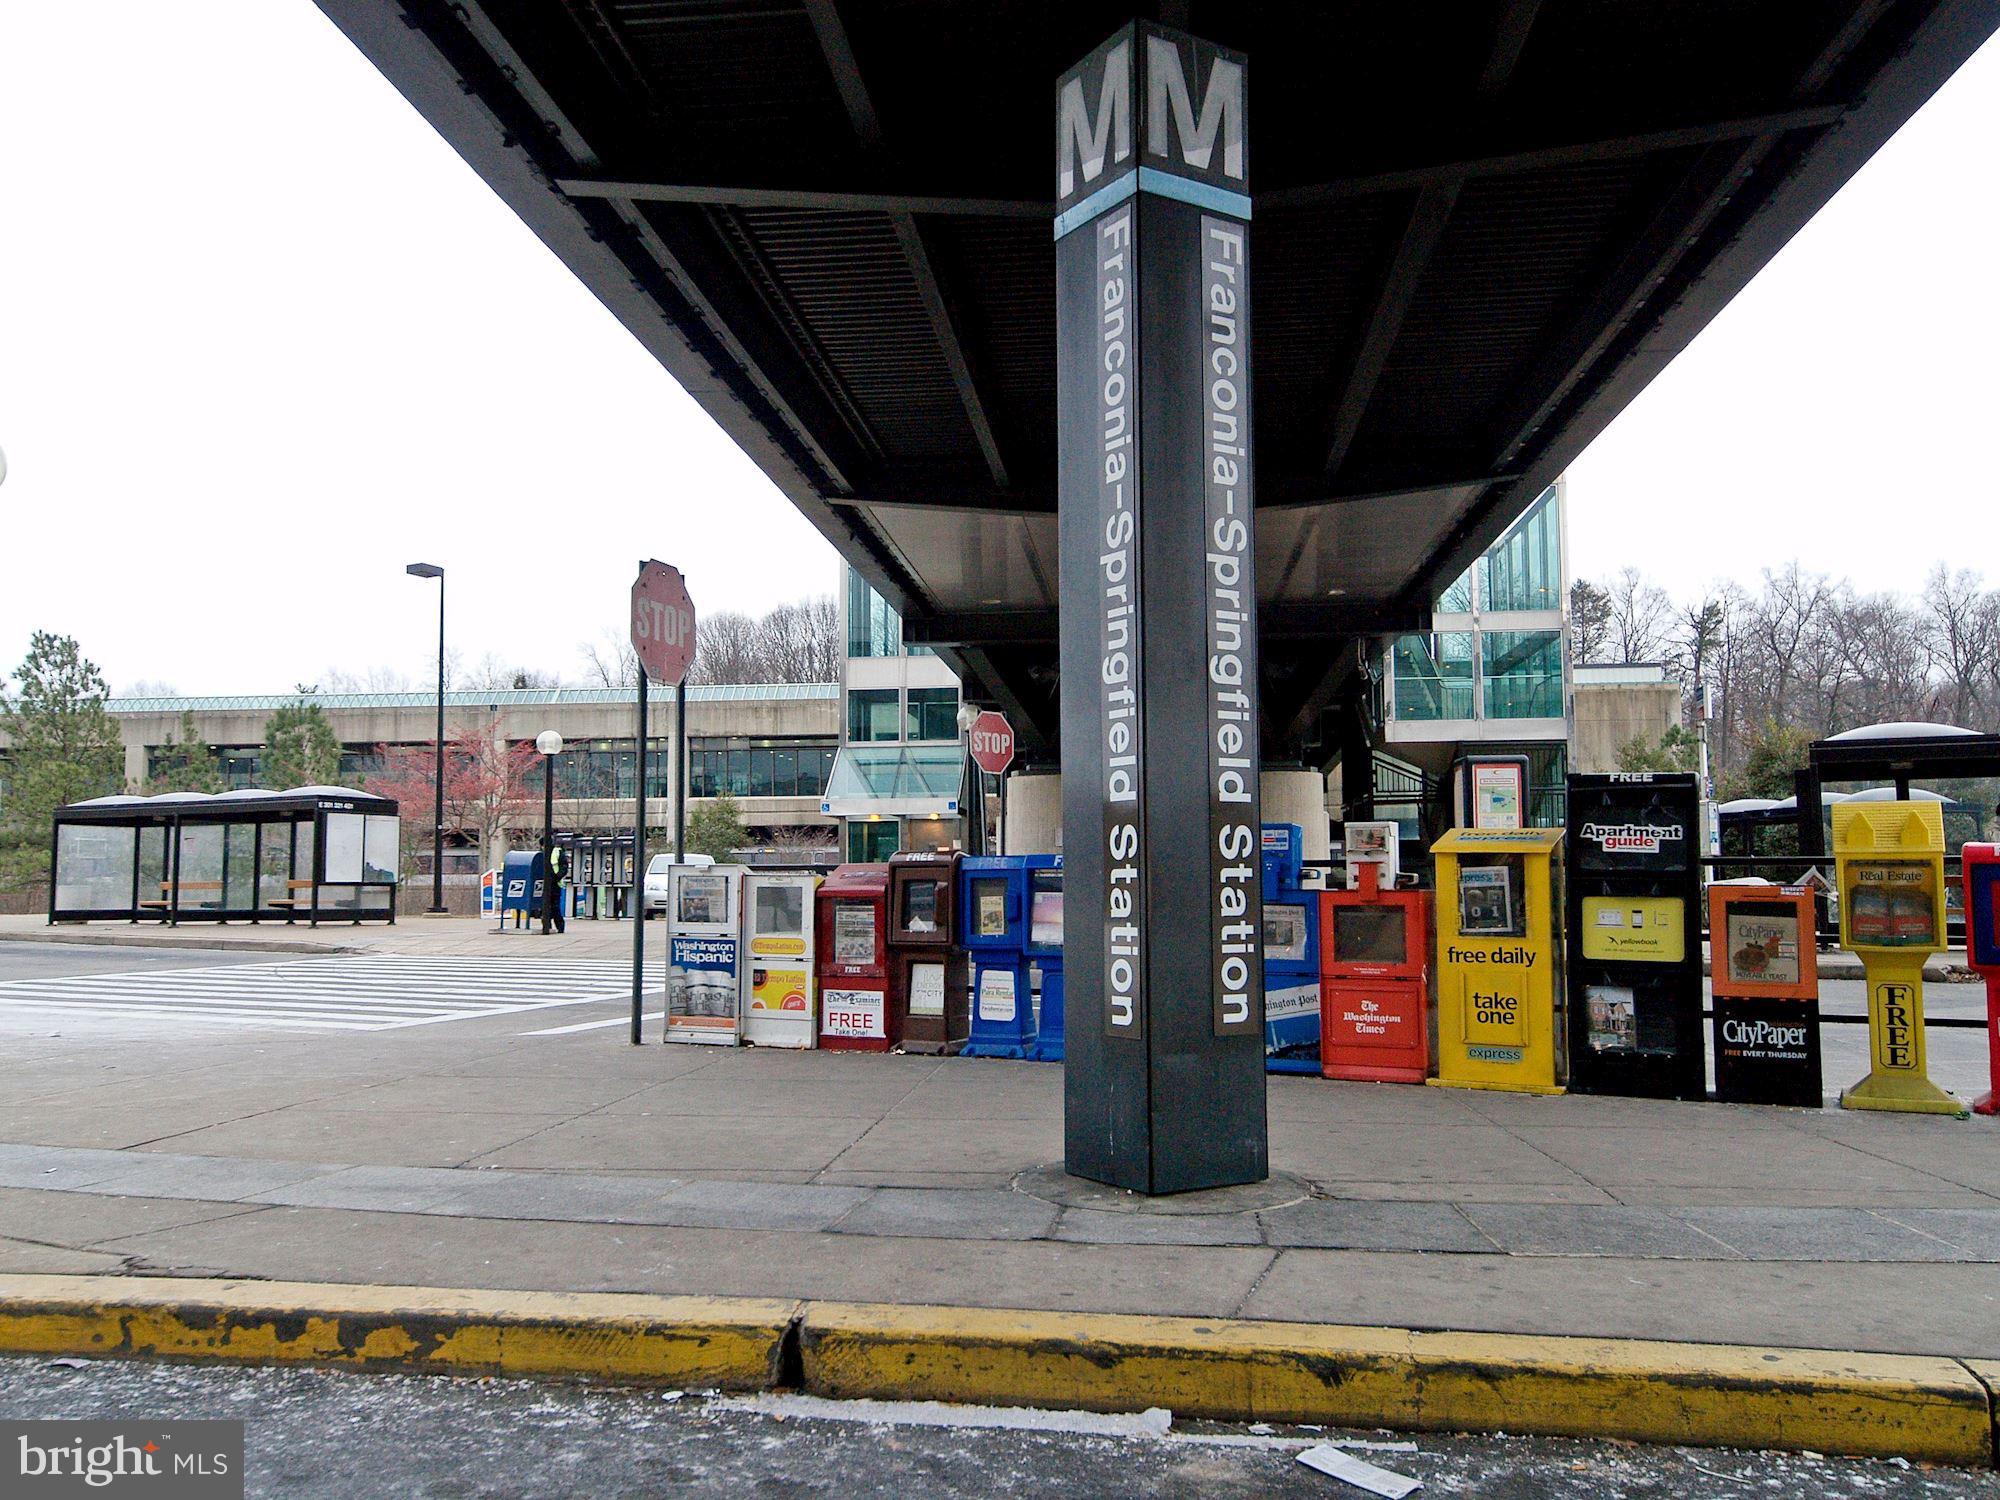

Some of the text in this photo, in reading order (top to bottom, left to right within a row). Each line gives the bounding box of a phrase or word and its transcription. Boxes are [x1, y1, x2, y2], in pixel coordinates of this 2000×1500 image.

[1147, 34, 1243, 180] M
[1060, 38, 1130, 200] M
[637, 596, 691, 648] STOP
[973, 732, 1010, 755] STOP
[1609, 774, 1654, 782] FREE
[1581, 824, 1681, 838] Apartment
[1605, 833, 1655, 849] guide
[906, 853, 936, 861] FREE
[1860, 871, 1922, 882] Real Estate
[1110, 824, 1138, 1025] Station
[1218, 824, 1254, 1024] Station
[1739, 924, 1784, 940] CityPaper
[674, 940, 734, 952] Washington
[675, 950, 733, 964] Hispanic
[1448, 946, 1536, 967] free daily
[1299, 993, 1318, 1007] Post
[1361, 1000, 1379, 1012] The
[1473, 992, 1517, 1010] take
[829, 1012, 873, 1029] FREE
[1343, 1012, 1401, 1023] Washington
[1477, 1010, 1515, 1025] one
[1355, 1022, 1385, 1034] Times
[1884, 987, 1910, 1066] FREE
[1723, 1020, 1806, 1049] CityPaper
[1469, 1048, 1520, 1060] express
[1724, 1049, 1807, 1059] FREE EVERY THURSDAY
